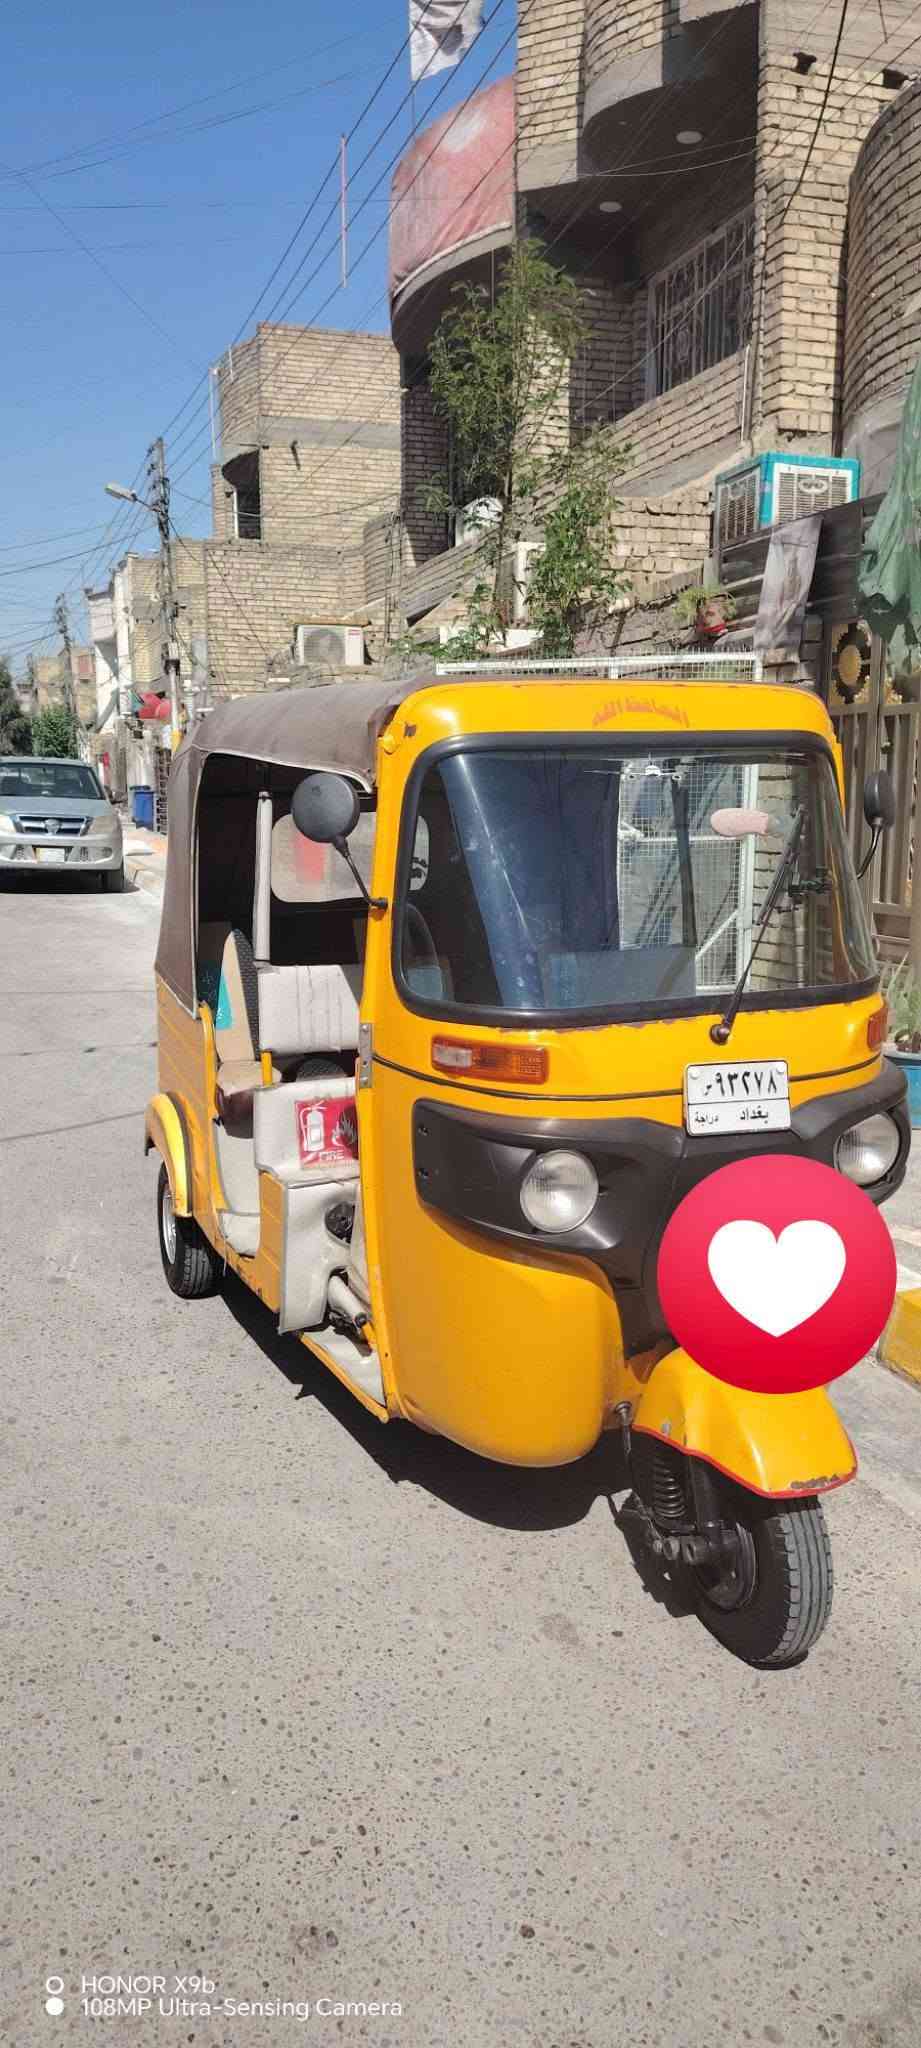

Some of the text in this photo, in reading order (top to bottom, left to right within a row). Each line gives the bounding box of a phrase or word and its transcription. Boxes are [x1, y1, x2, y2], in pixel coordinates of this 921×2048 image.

[715, 1070, 778, 1097] ٩٣٢٧٨
[694, 1105, 769, 1126] بغداد دراجة
